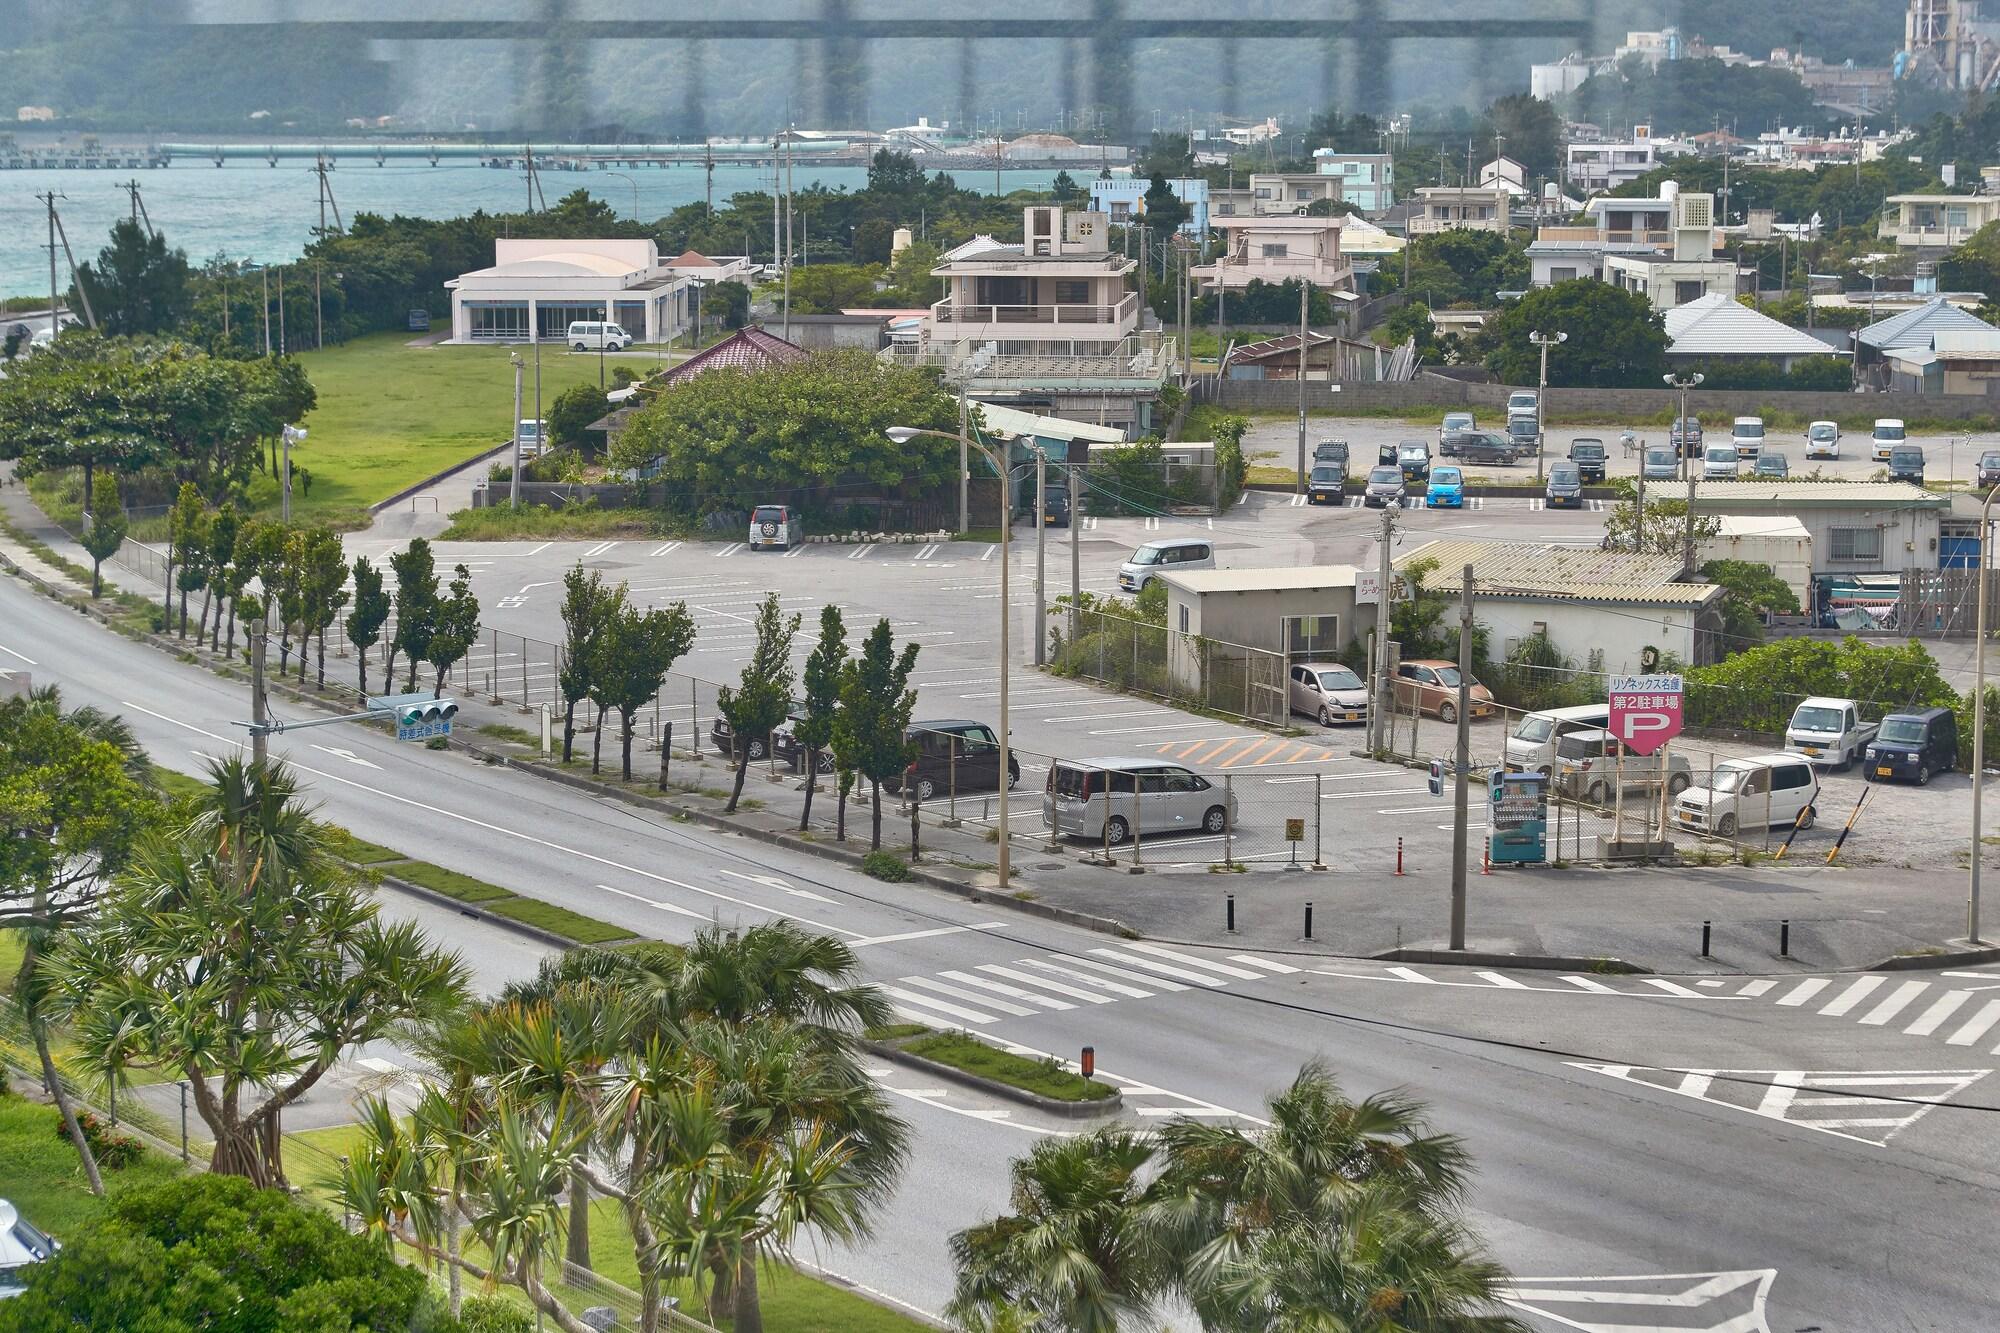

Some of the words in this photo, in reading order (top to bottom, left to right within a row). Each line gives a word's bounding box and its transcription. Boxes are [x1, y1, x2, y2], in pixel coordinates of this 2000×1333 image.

[1389, 575, 1410, 600] 虎
[1613, 695, 1679, 710] 第2駐車場
[1624, 713, 1671, 739] P
